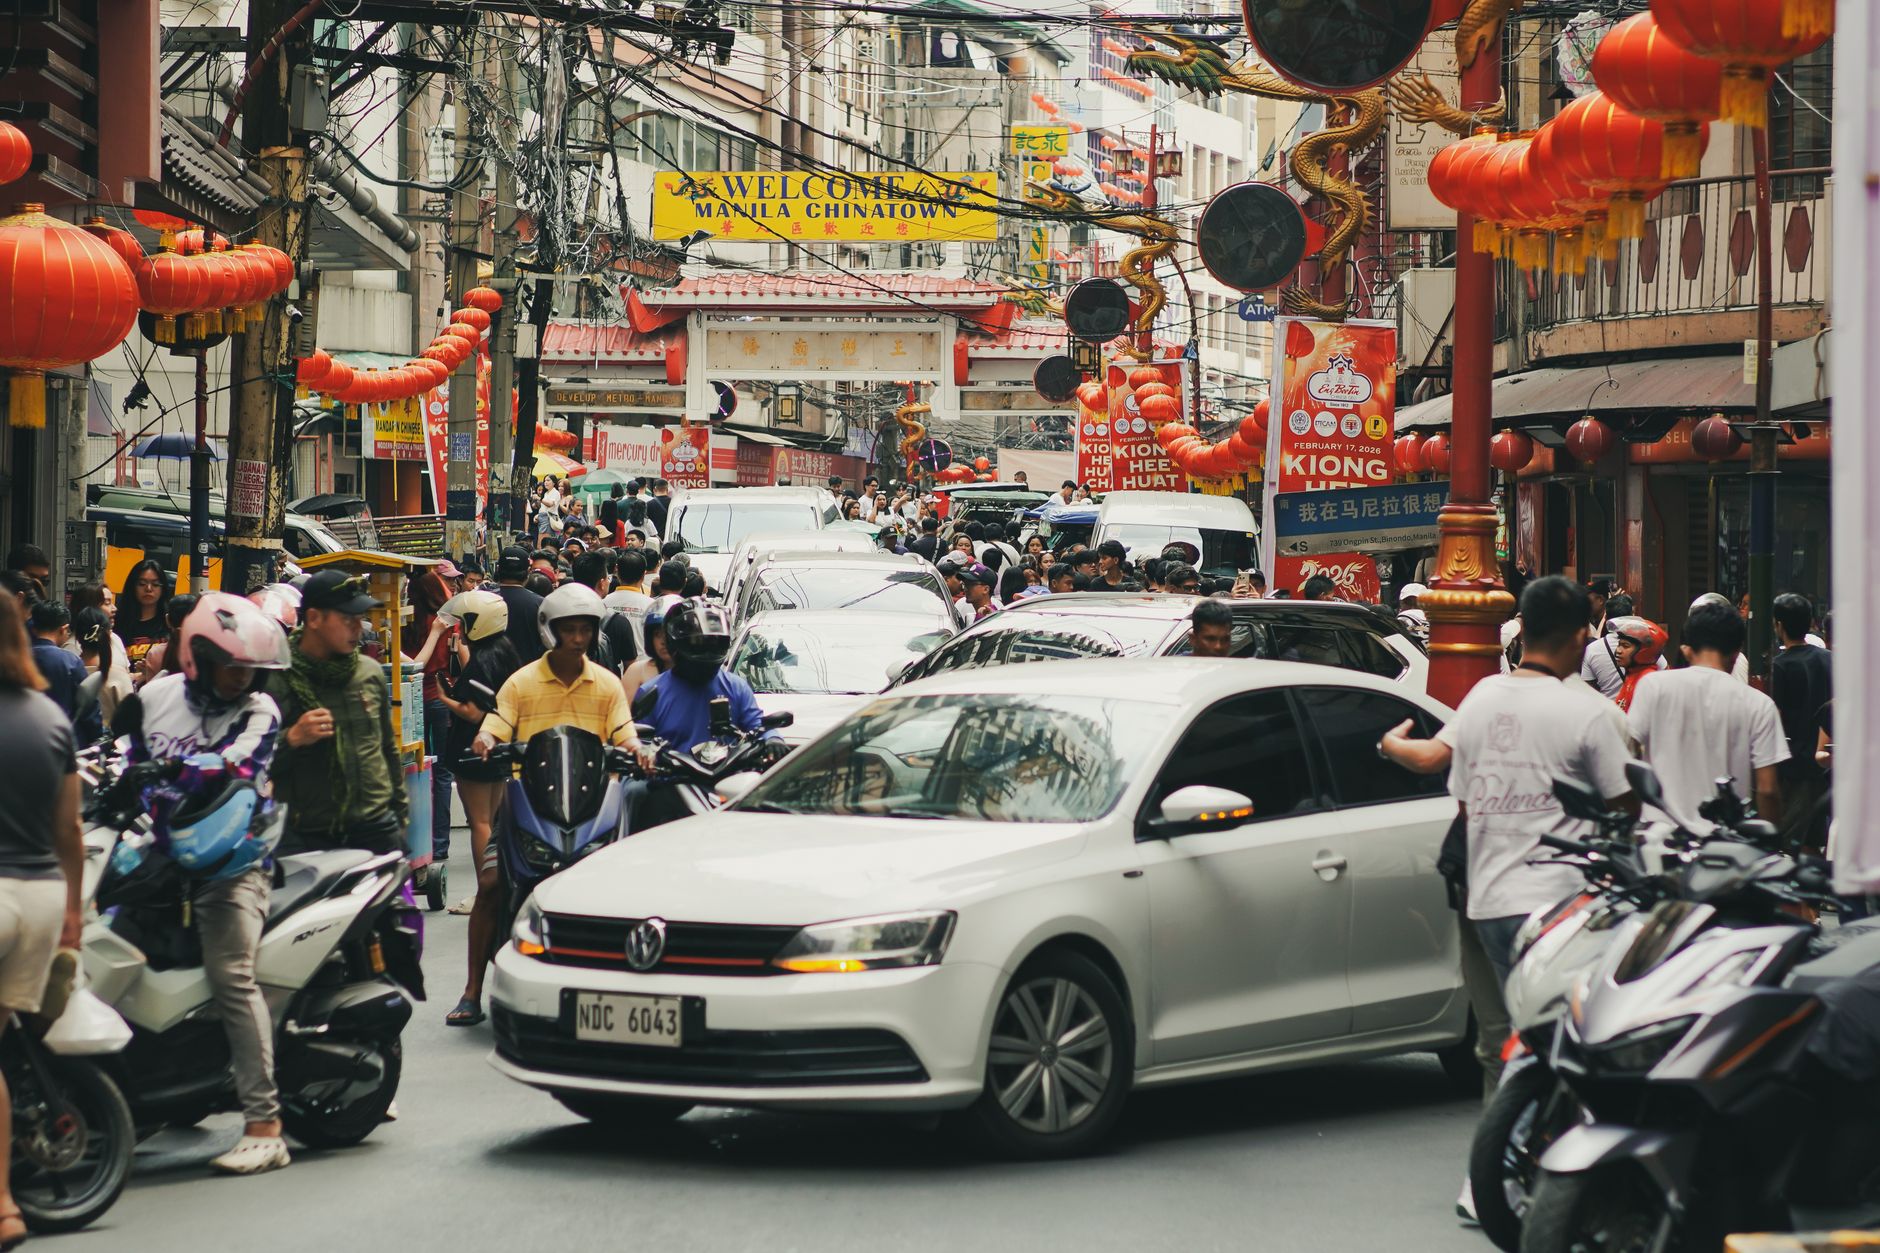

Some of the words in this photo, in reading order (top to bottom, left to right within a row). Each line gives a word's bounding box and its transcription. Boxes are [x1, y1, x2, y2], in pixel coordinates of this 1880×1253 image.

[1394, 167, 1424, 177] Lucky
[721, 175, 905, 200] WELCOME
[695, 202, 791, 218] MANILA
[805, 203, 957, 219] CHINATOWN
[606, 393, 635, 404] METRO
[608, 441, 648, 466] mercury
[1294, 442, 1342, 451] FEBRUARY
[1359, 446, 1381, 454] 2026
[1129, 458, 1171, 473] HEE
[1285, 454, 1388, 481] KIONG
[243, 473, 265, 484] NEGRO
[1122, 474, 1178, 490] HUAT
[1279, 499, 1290, 511] 南
[1299, 541, 1308, 552] S
[1329, 540, 1343, 548] 739
[1343, 537, 1369, 548] Ongpin
[579, 1004, 615, 1031] NDC
[628, 1006, 677, 1036] 6043
